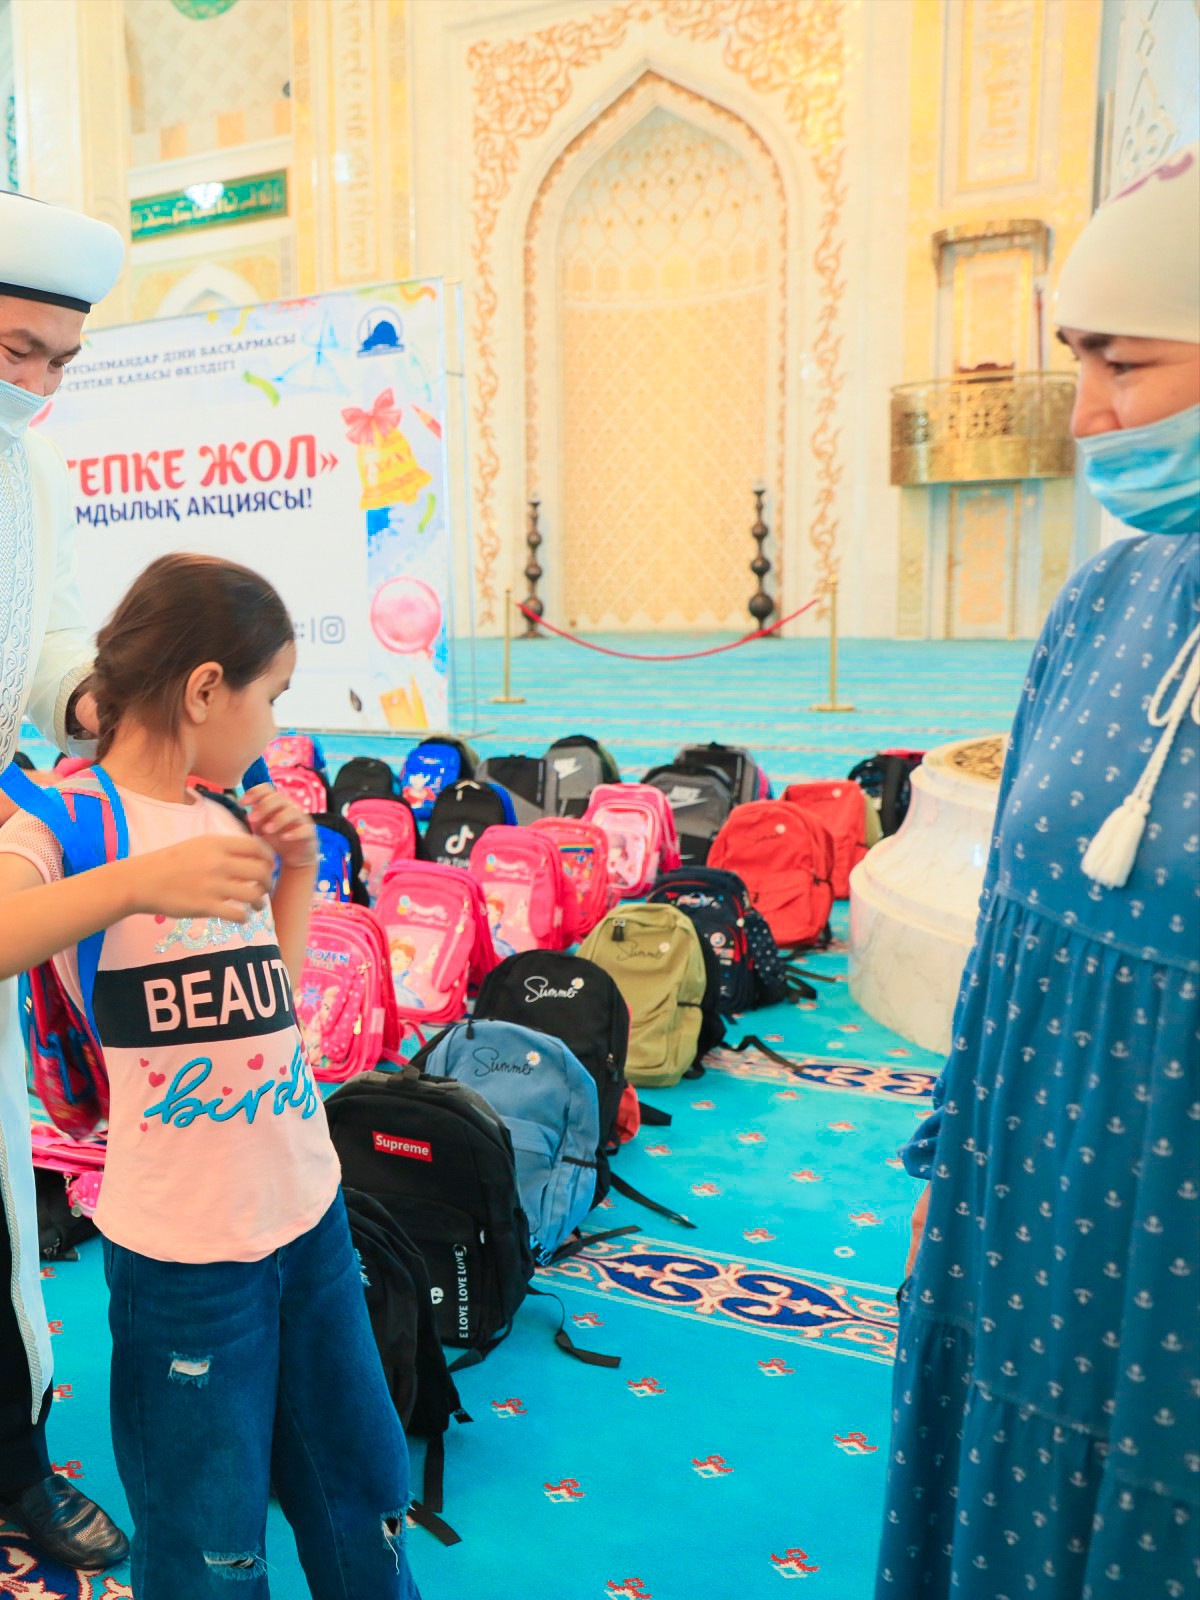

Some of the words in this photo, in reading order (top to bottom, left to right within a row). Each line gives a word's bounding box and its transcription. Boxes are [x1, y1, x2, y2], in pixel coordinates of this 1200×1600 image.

[200, 333, 296, 357] БАСҚАРМАСЫ
[198, 434, 339, 487] ЖОЛ»
[187, 486, 313, 518] АКЦИЯСЫ!
[143, 958, 292, 1033] BEAUT
[472, 1046, 534, 1078] Summer
[375, 1134, 430, 1156] Supreme
[454, 1250, 467, 1275] LOVE
[457, 1277, 469, 1302] LOVE
[458, 1305, 469, 1331] LOVE
